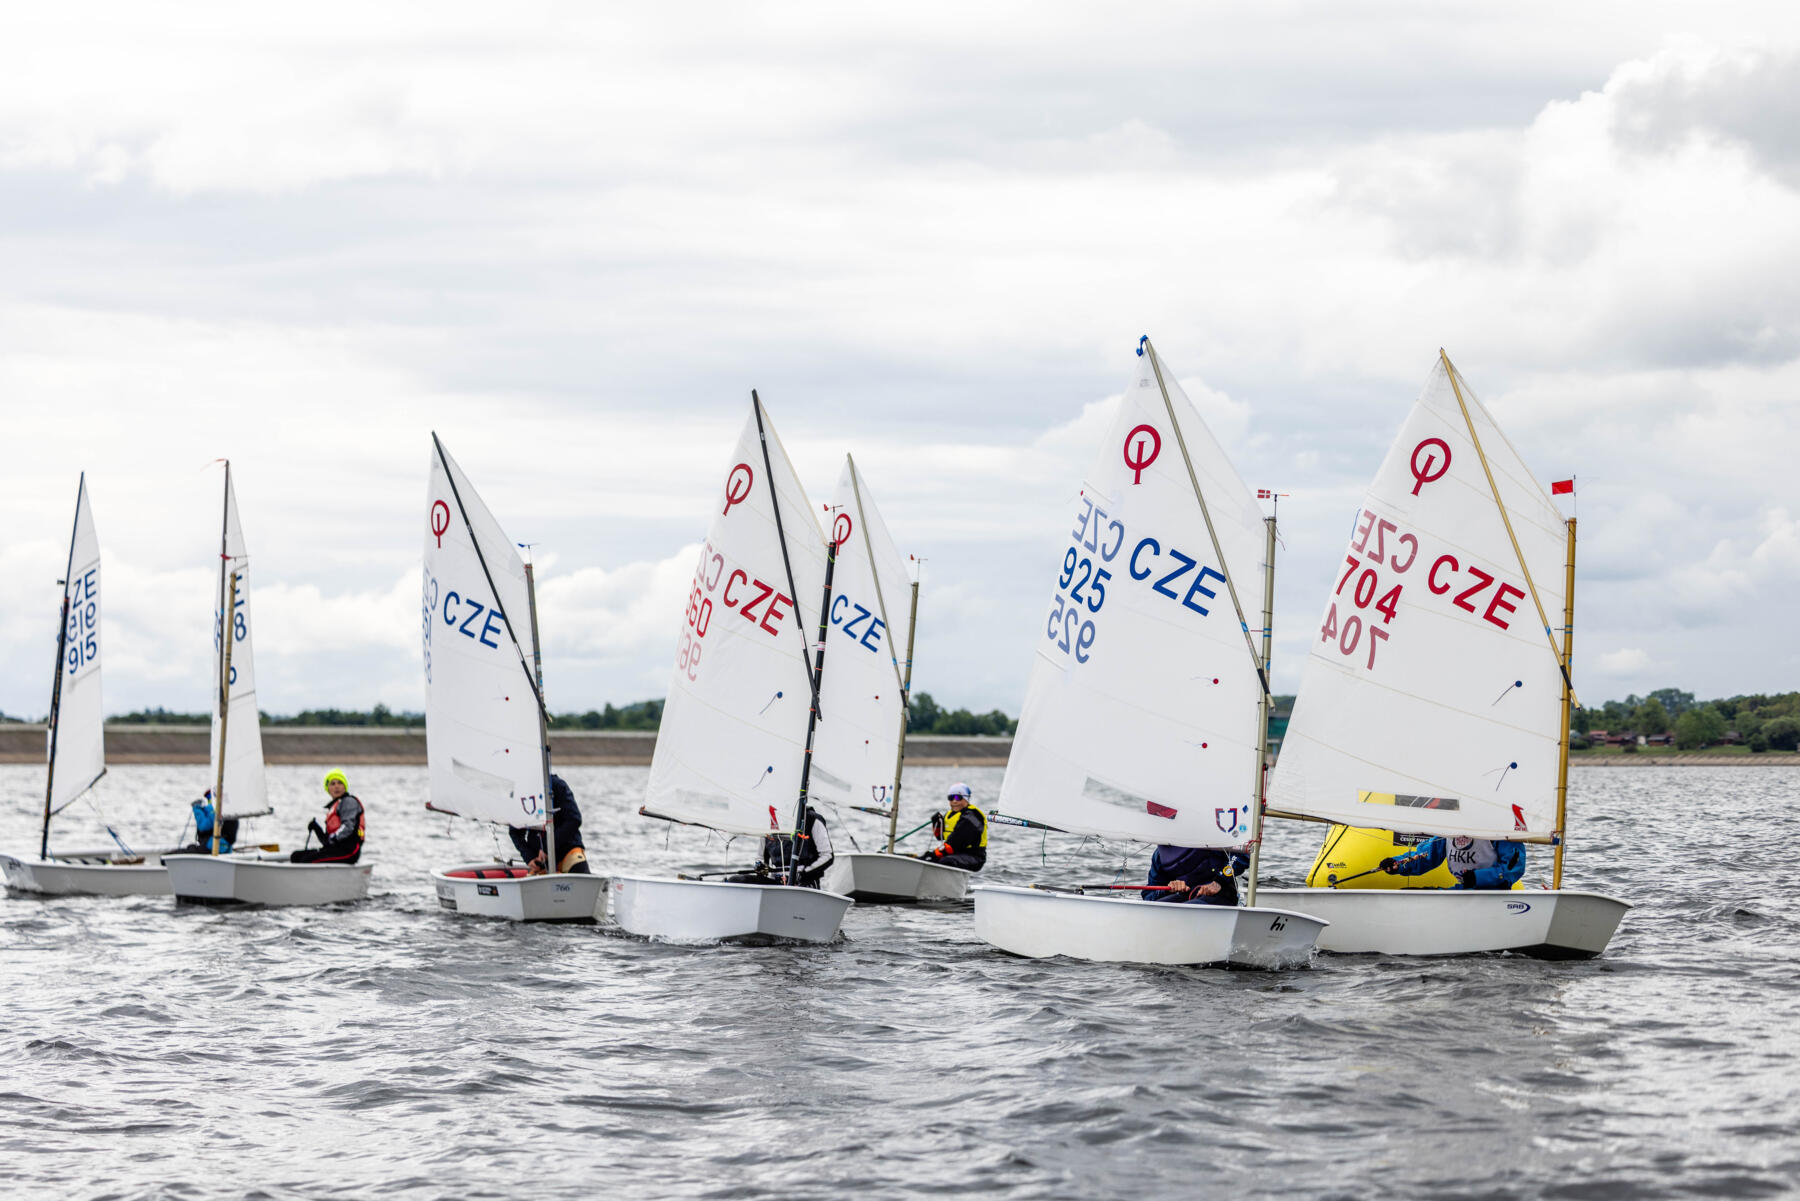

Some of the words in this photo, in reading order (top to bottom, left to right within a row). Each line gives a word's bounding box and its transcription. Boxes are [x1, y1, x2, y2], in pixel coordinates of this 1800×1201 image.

[723, 568, 794, 637] CZE
[1059, 547, 1112, 613] 925
[1129, 538, 1227, 617] CZE
[1336, 554, 1403, 624] 704
[1427, 554, 1526, 630] CZE
[444, 591, 504, 650] CZE
[831, 594, 887, 653] CZE
[68, 631, 97, 675] 915
[1449, 849, 1477, 864] HKK
[555, 884, 571, 892] 766
[1270, 915, 1289, 931] hi
